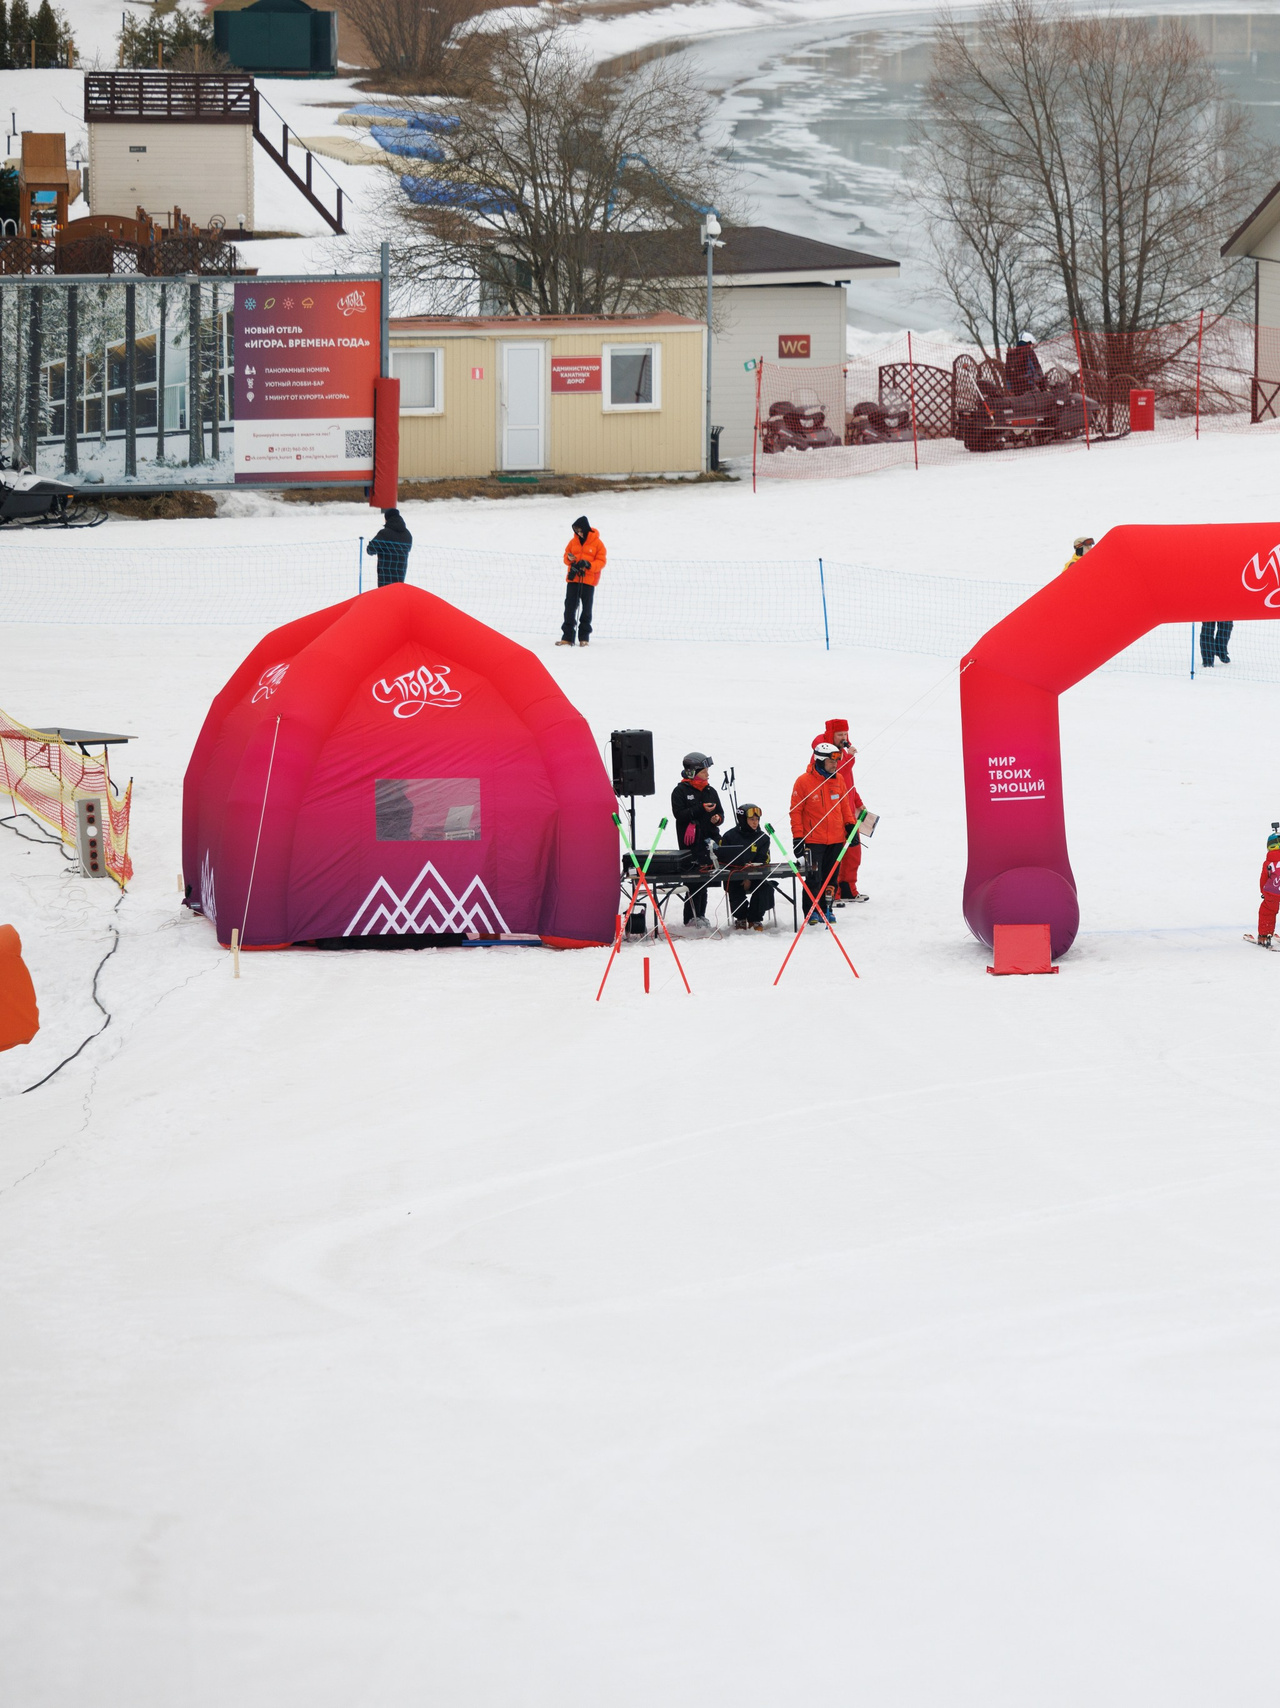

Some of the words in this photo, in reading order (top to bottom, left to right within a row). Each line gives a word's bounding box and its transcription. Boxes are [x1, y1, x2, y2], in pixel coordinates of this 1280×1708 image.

[244, 325, 275, 335] НОВЫЙ
[276, 326, 303, 334] ОТЕЛЬ
[244, 339, 287, 349] «ИГОРА.
[288, 338, 336, 348] ВРЕМЕНА
[337, 338, 371, 348] ГОДА»
[781, 340, 808, 354] WC
[988, 756, 1016, 767] МИР
[988, 768, 1032, 780] ТВОИХ
[989, 779, 1046, 793] ЭМОЦИЙ
